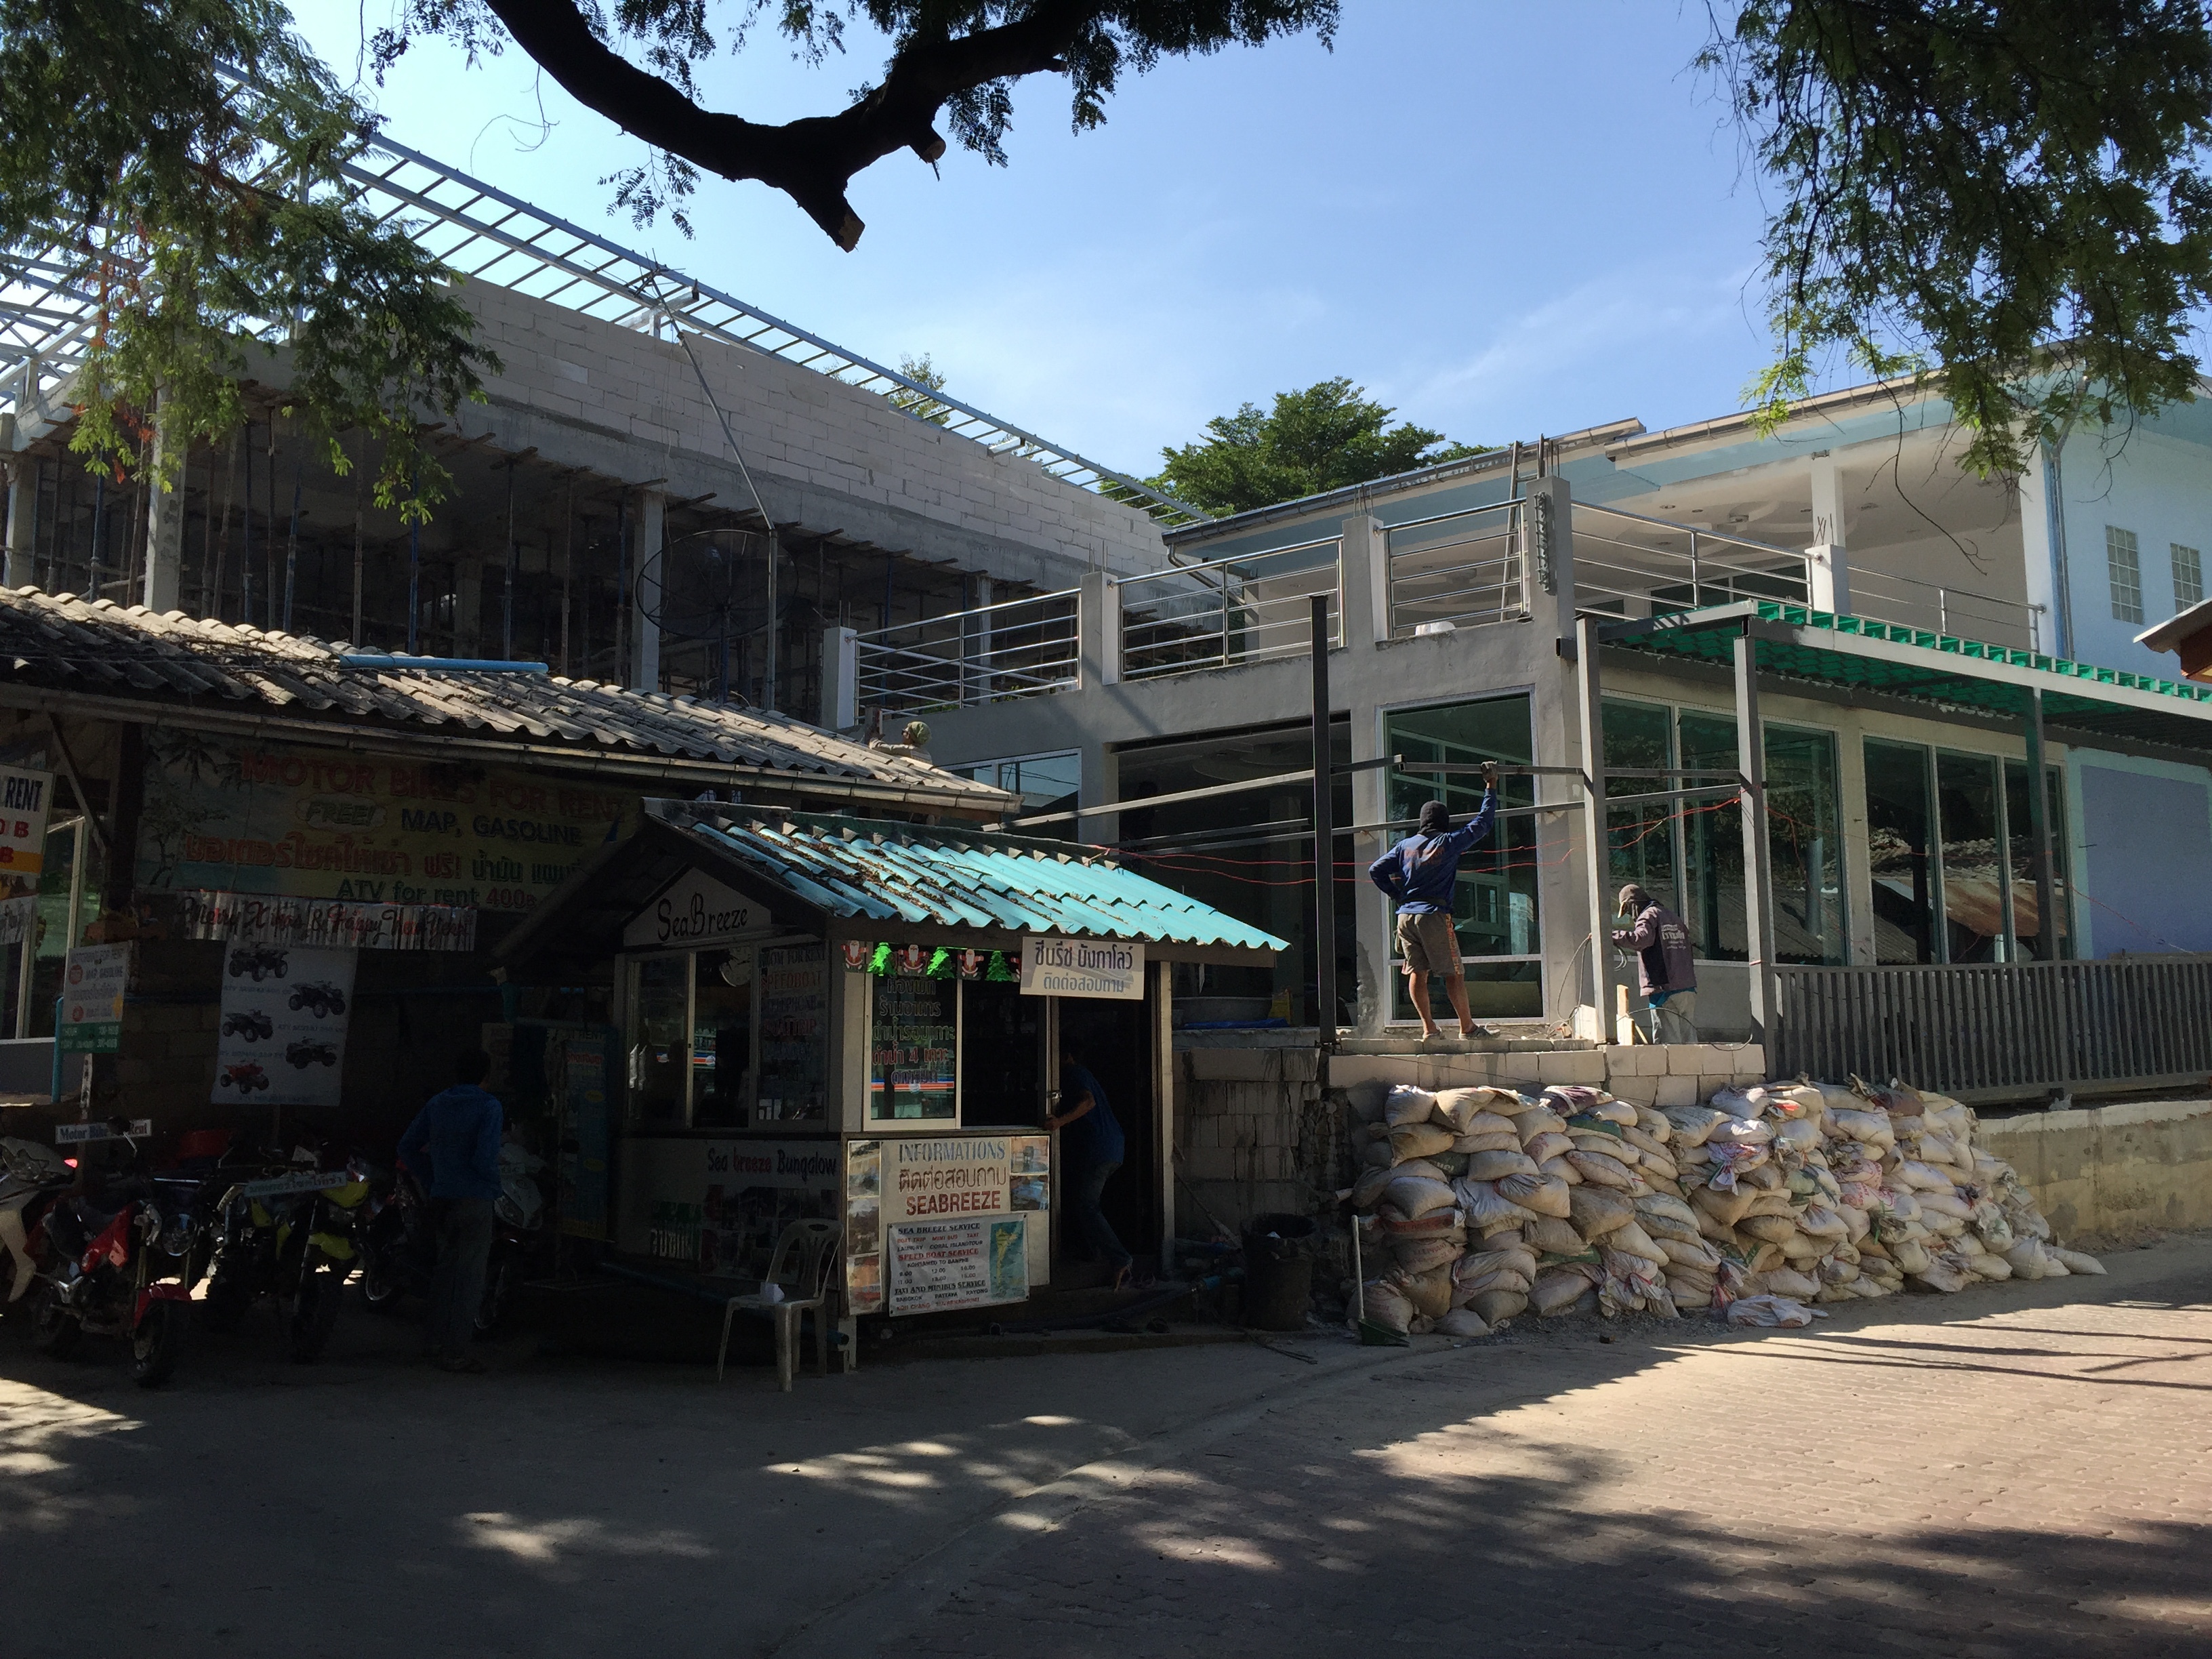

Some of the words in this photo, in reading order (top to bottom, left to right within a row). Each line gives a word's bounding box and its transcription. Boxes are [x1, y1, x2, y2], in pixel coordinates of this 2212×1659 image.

[5, 776, 43, 812] RENT
[242, 751, 375, 793] MOTOR
[490, 779, 548, 813] FOR
[402, 808, 462, 838] MAP,
[472, 815, 584, 847] GASOLINE
[337, 878, 384, 899] ATV
[392, 880, 428, 904] for
[434, 886, 480, 909] rent
[1078, 944, 1134, 970] บังกาโลว์
[1043, 972, 1125, 993] ติดต่อสอบถาม
[908, 1046, 920, 1064] 4
[60, 1127, 87, 1141] Motor
[708, 1147, 729, 1172] Sea
[733, 1146, 772, 1173] breeze
[777, 1149, 837, 1184] Bungalow
[899, 1141, 1006, 1164] INFORMATIONS
[899, 1165, 1007, 1193] ติดต่อสอบถาม
[906, 1190, 1002, 1216] SEABREEZE
[916, 1225, 947, 1233] BREEZE
[949, 1223, 981, 1231] SERVICE
[898, 1252, 924, 1261] SPEED
[948, 1248, 979, 1256] SERVICE
[894, 1287, 909, 1296] TAXI
[910, 1286, 926, 1294] AND
[957, 1279, 986, 1288] SERVICE
